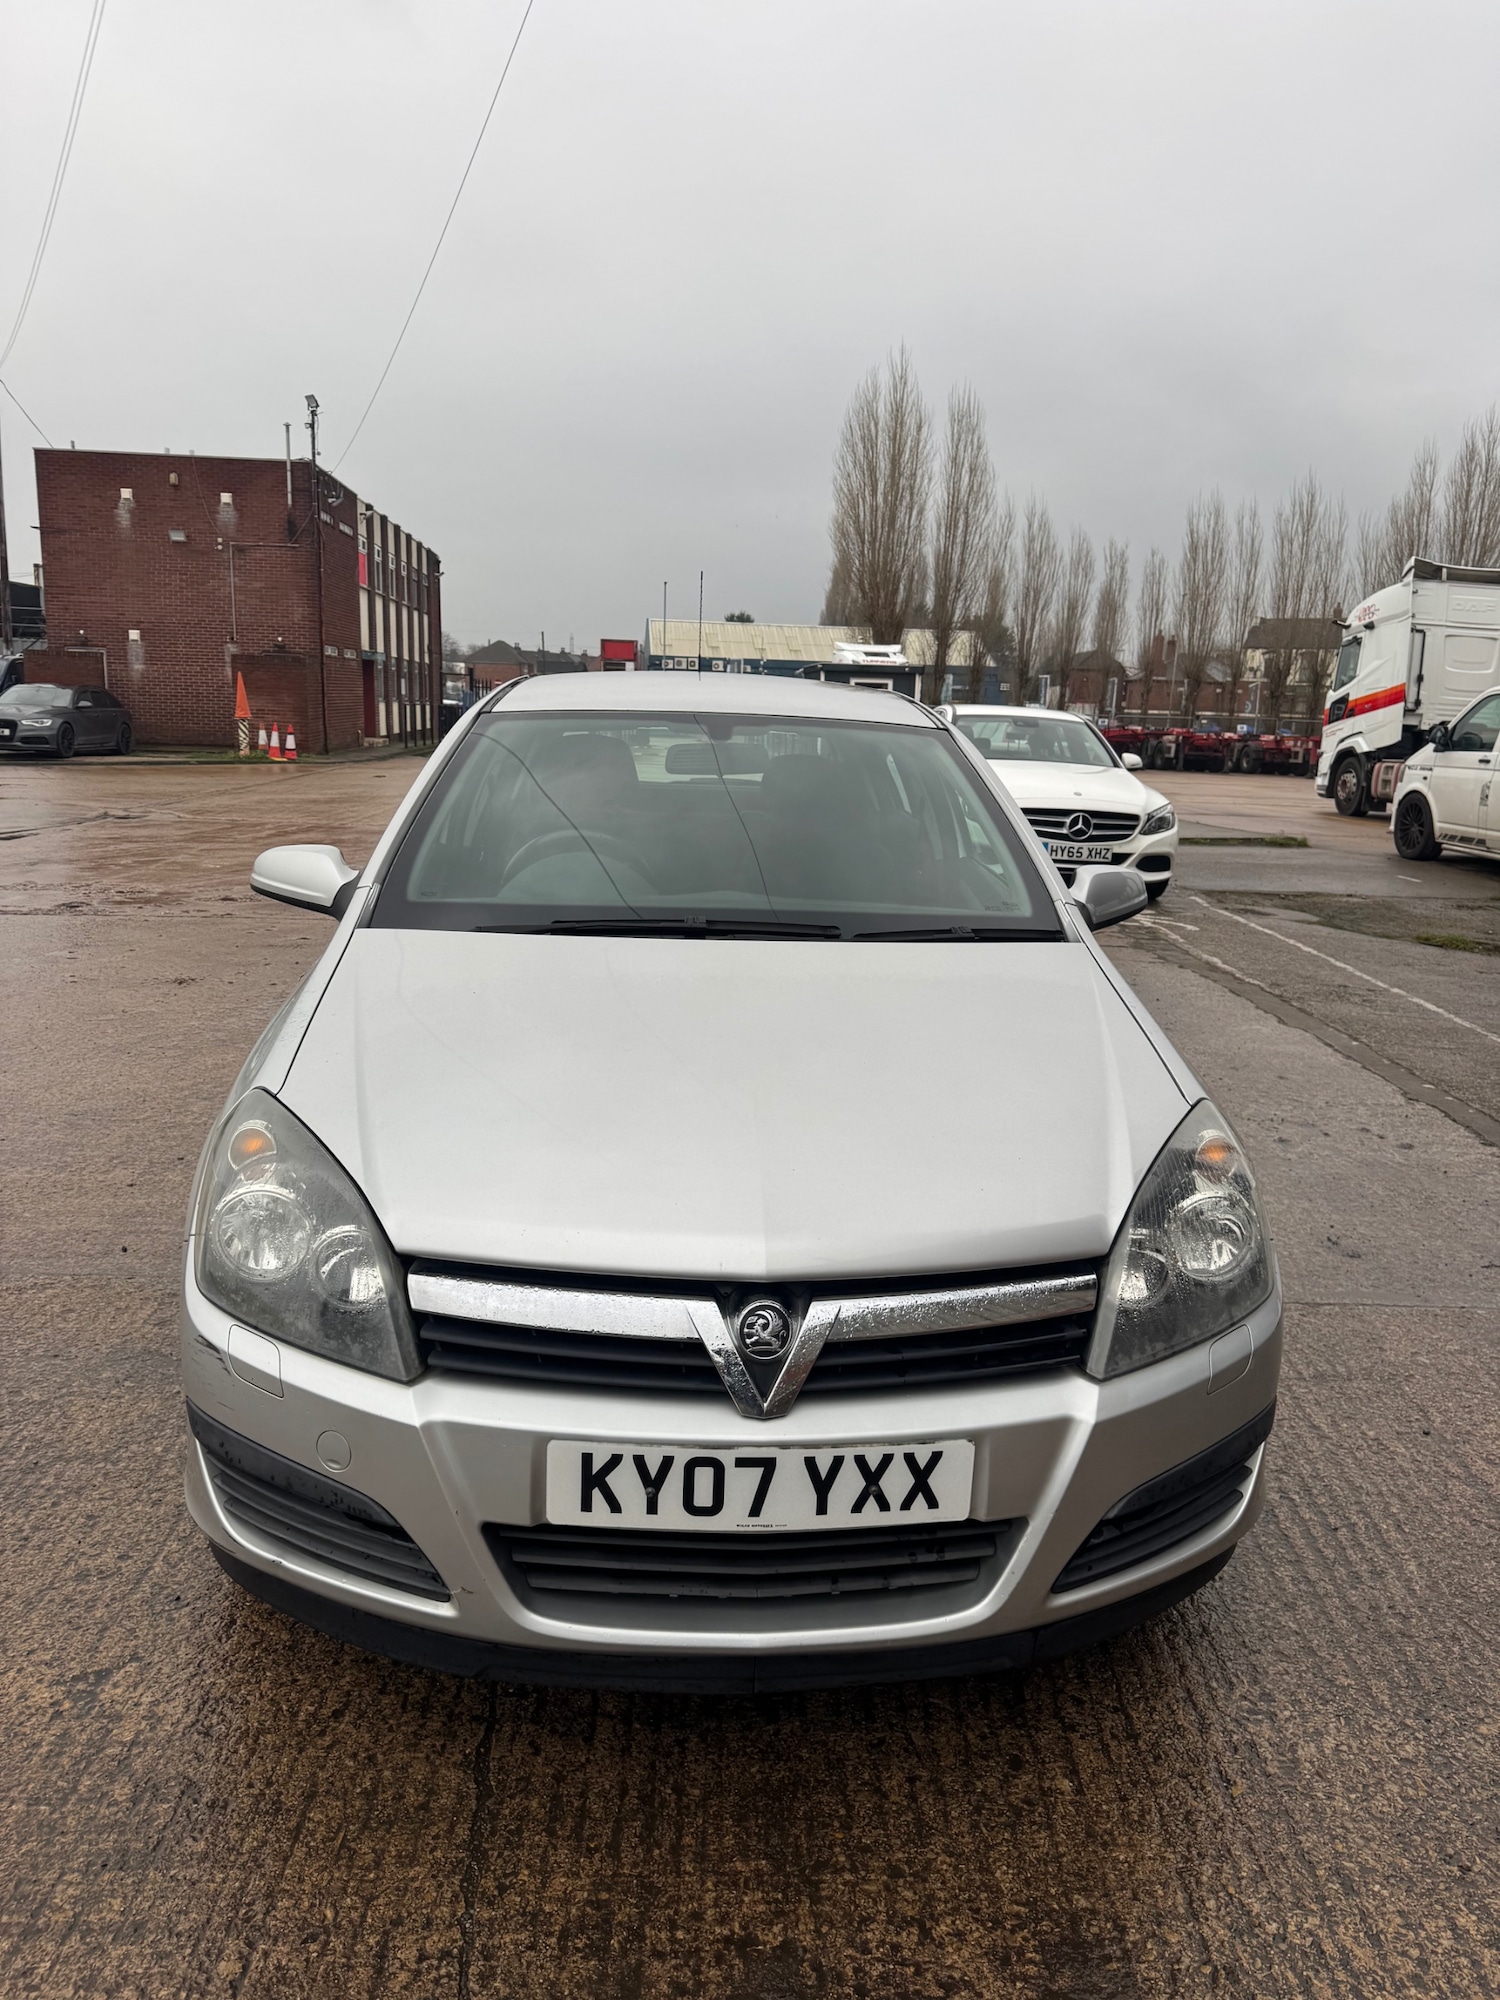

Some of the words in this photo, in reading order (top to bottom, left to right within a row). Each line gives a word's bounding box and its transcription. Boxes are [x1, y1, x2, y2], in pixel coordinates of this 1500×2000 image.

[1050, 845, 1083, 858] HY65
[1086, 847, 1111, 860] XHZ
[580, 1452, 777, 1518] KY07
[803, 1451, 943, 1516] YXX
